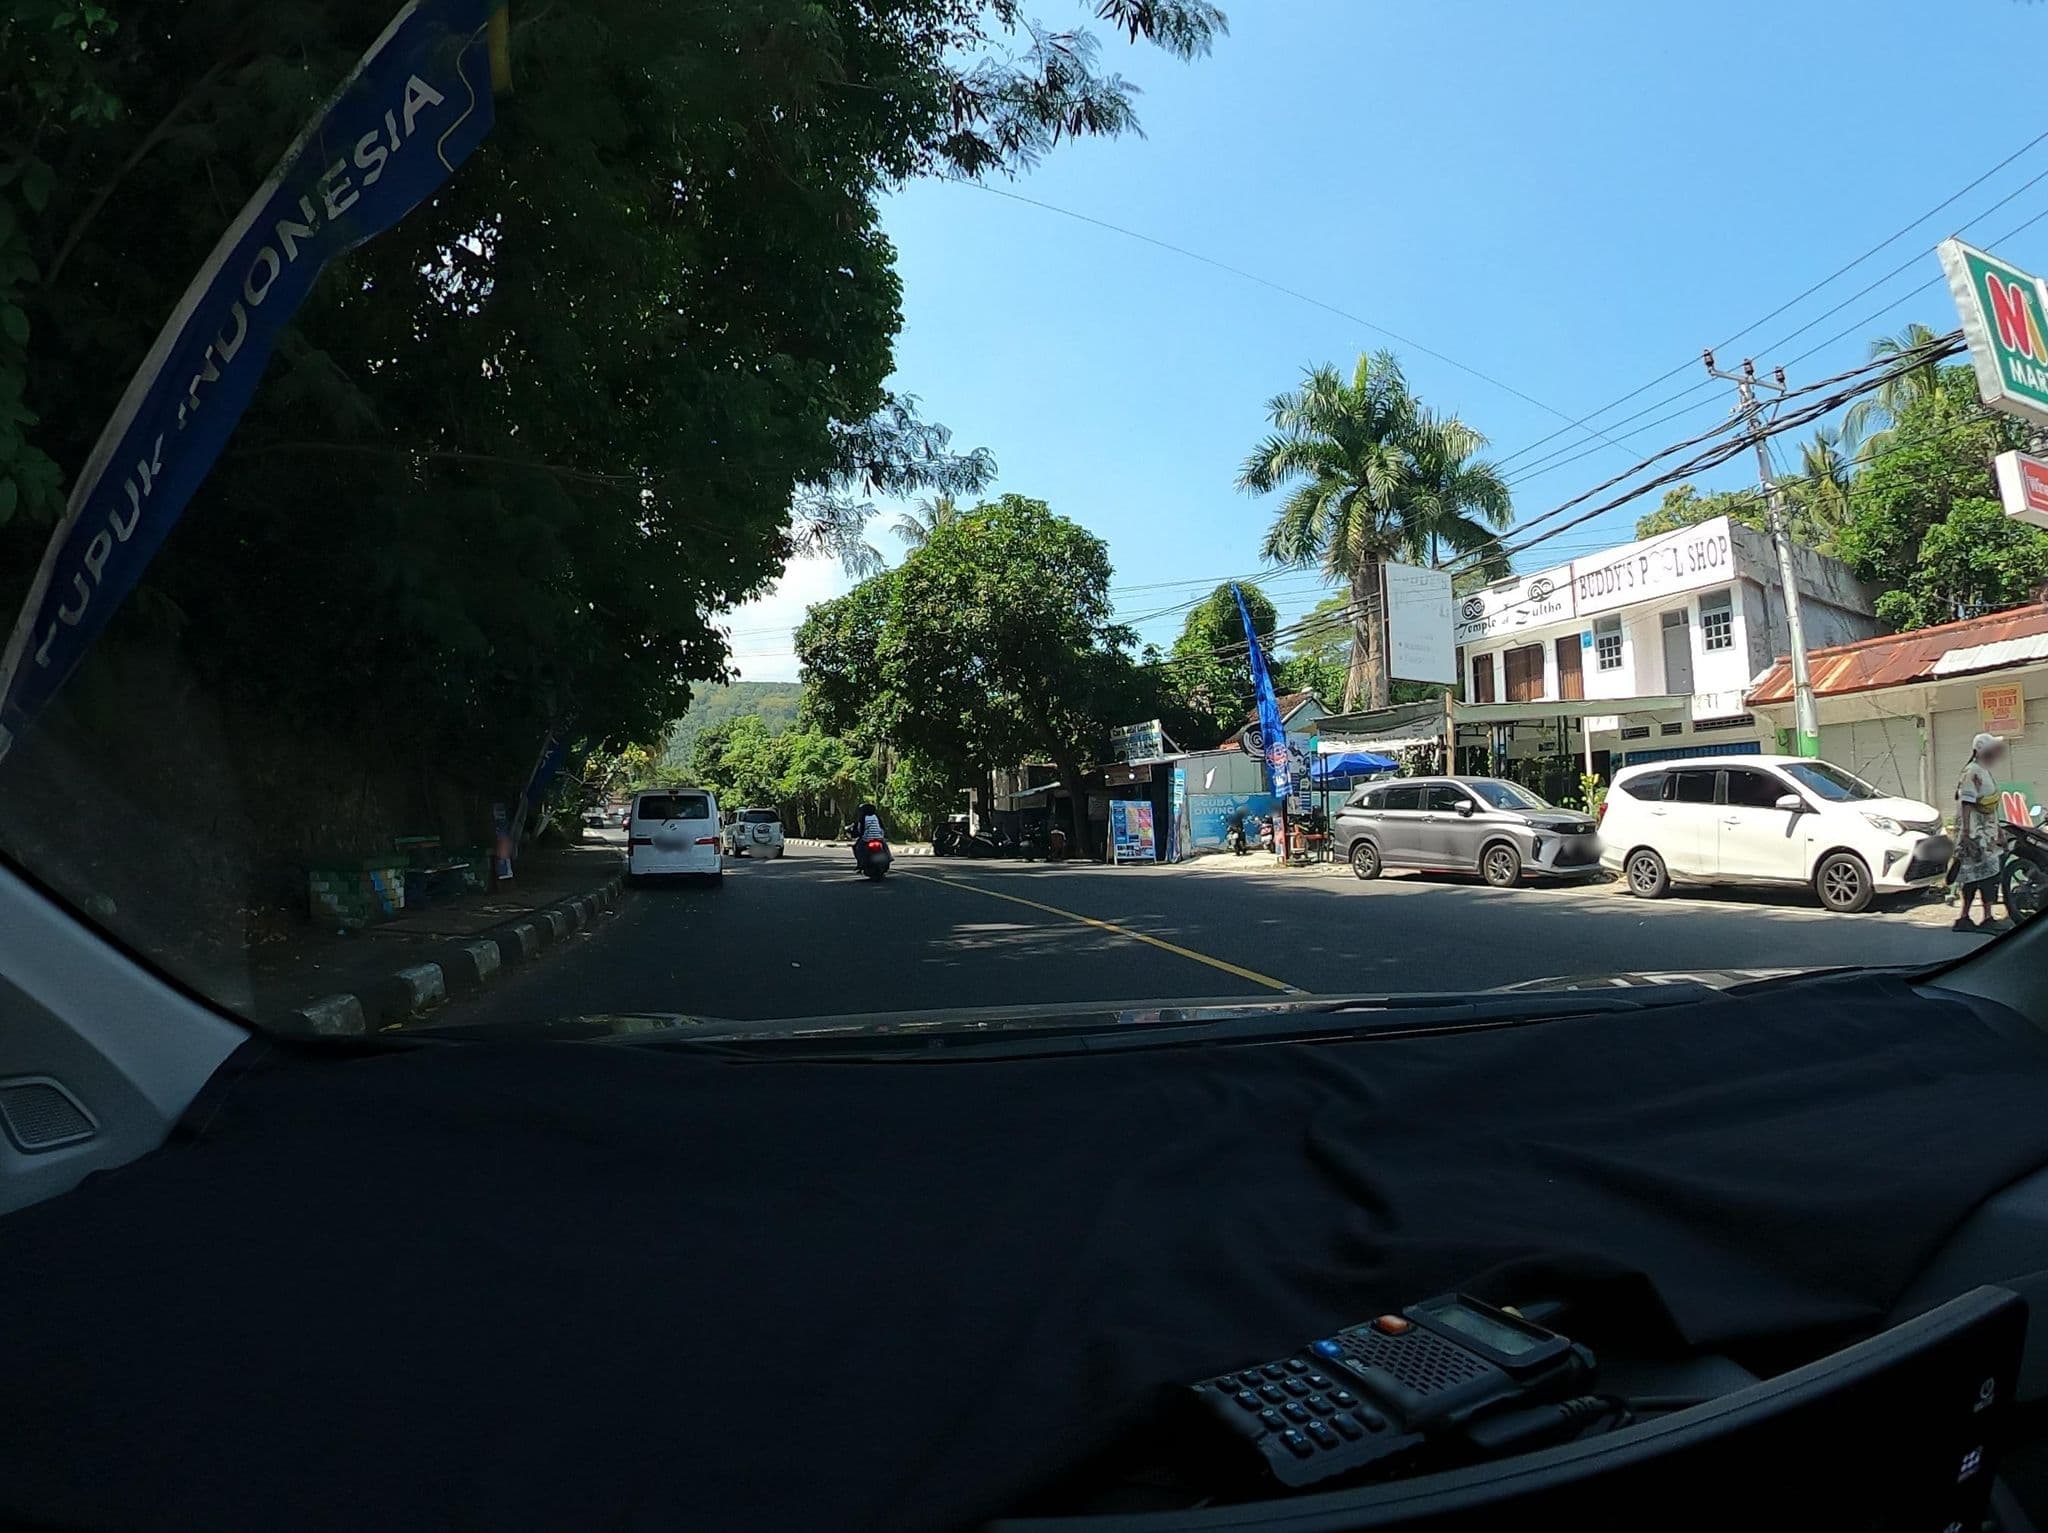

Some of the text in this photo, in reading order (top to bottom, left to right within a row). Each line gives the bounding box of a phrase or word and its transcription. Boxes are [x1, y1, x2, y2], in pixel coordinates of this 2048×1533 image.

[1579, 561, 1634, 600] BUDDY'S
[1689, 535, 1728, 572] SHOP
[1456, 616, 1497, 639] Temple
